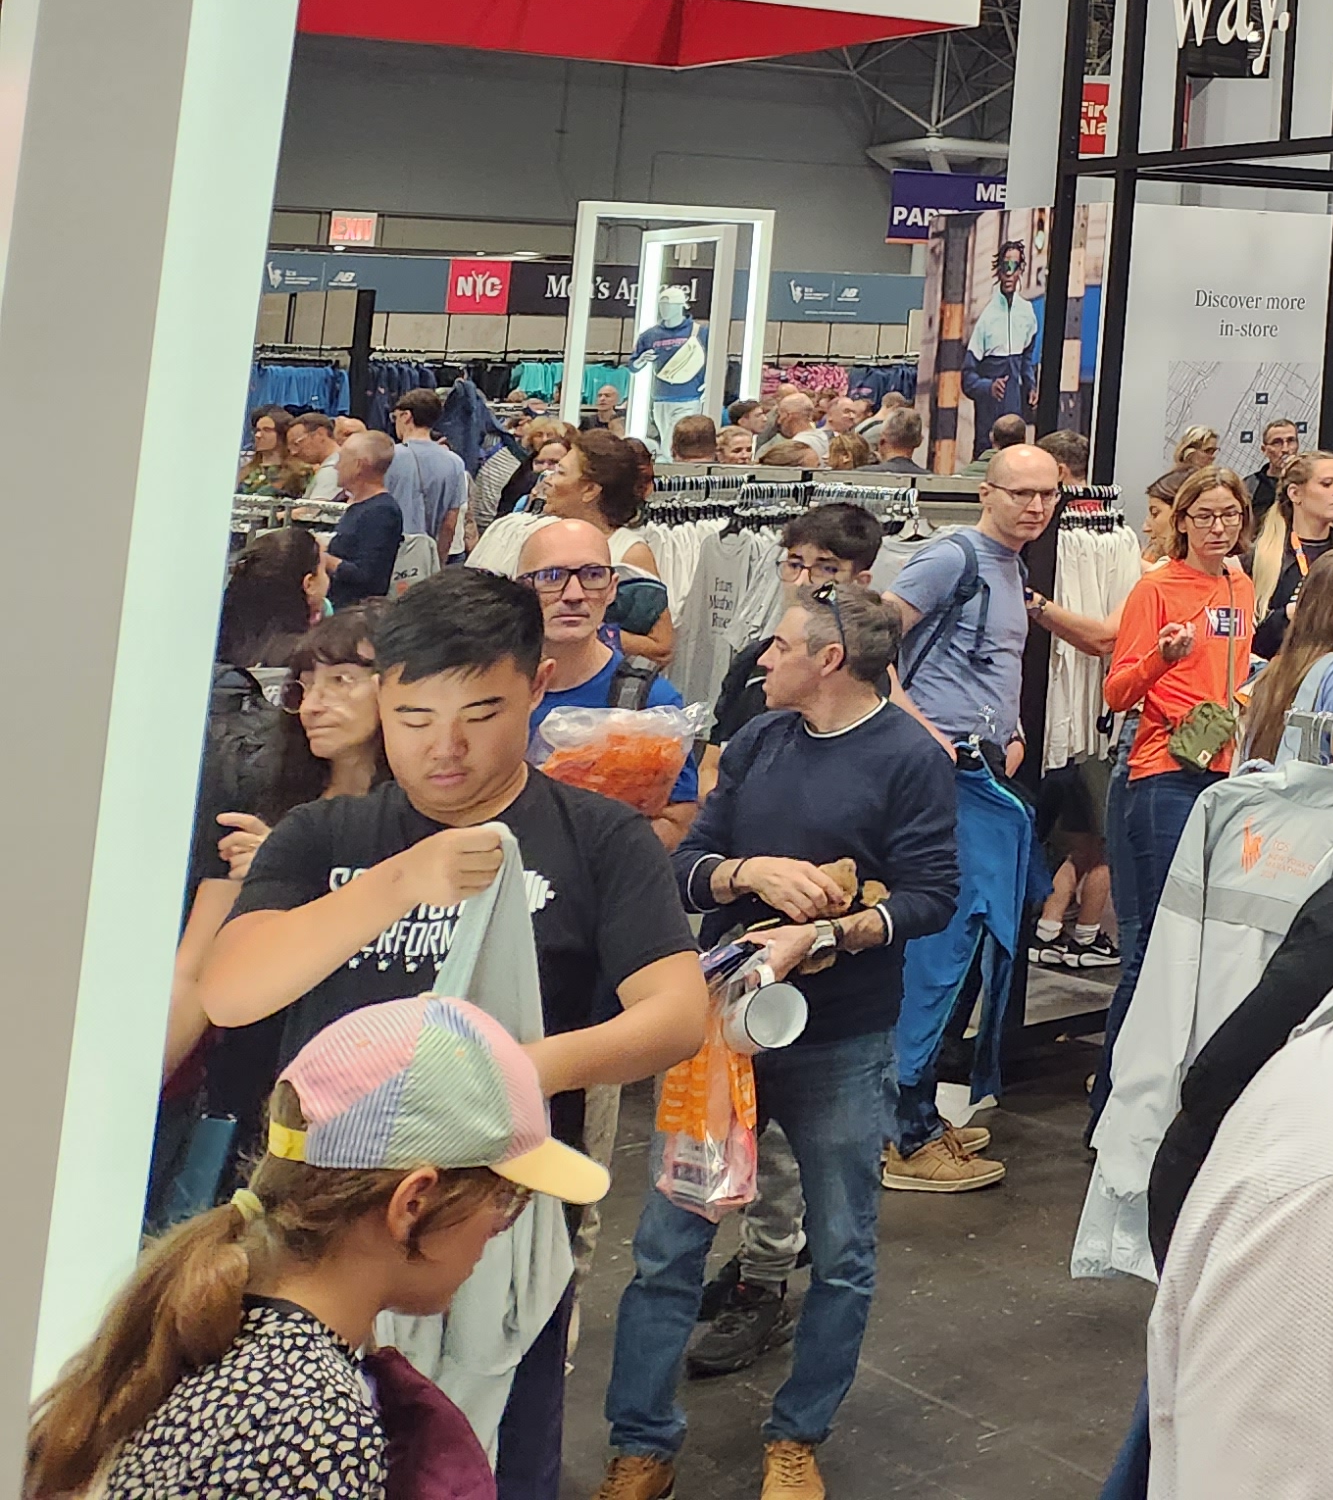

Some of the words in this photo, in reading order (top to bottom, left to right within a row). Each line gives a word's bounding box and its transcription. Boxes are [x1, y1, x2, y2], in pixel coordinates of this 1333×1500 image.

[1080, 118, 1107, 136] Ala
[333, 216, 374, 241] EXIT
[544, 274, 610, 300] M's
[1194, 289, 1263, 309] Discover
[1266, 296, 1306, 310] more
[1219, 319, 1279, 338] in-store
[393, 567, 419, 581] 26.2
